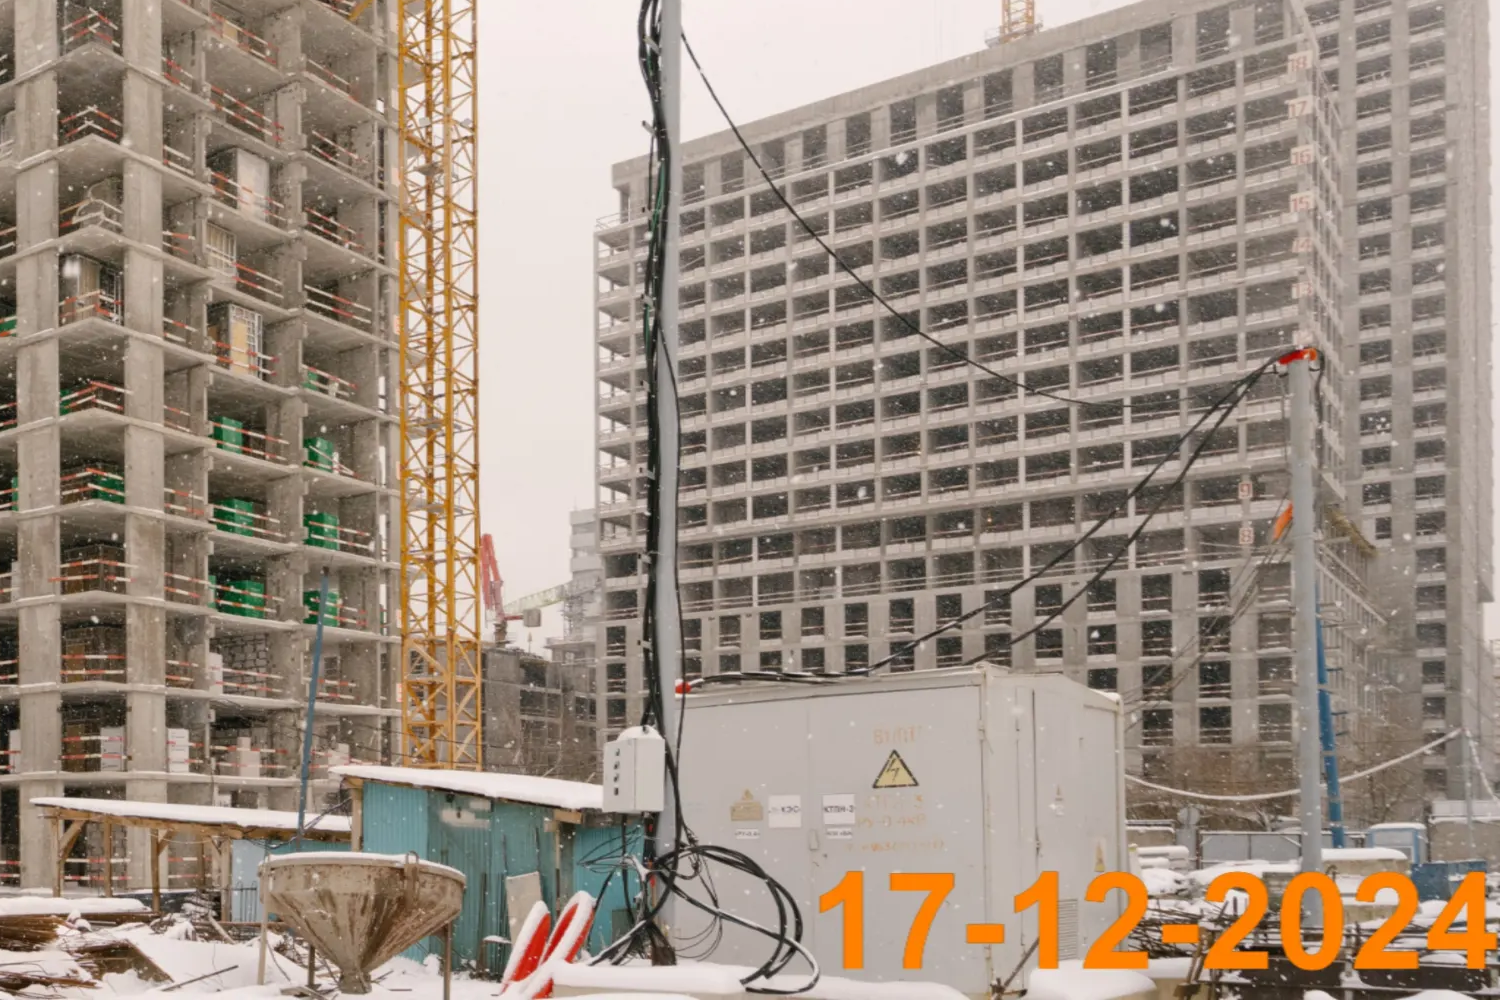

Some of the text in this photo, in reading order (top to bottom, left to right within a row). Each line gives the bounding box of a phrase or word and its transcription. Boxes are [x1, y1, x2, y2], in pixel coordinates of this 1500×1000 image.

[1291, 55, 1308, 71] 18
[1290, 100, 1307, 117] 17
[1292, 149, 1312, 164] 16
[1291, 195, 1310, 212] 15
[1240, 484, 1252, 497] 9
[1241, 529, 1253, 543] 8
